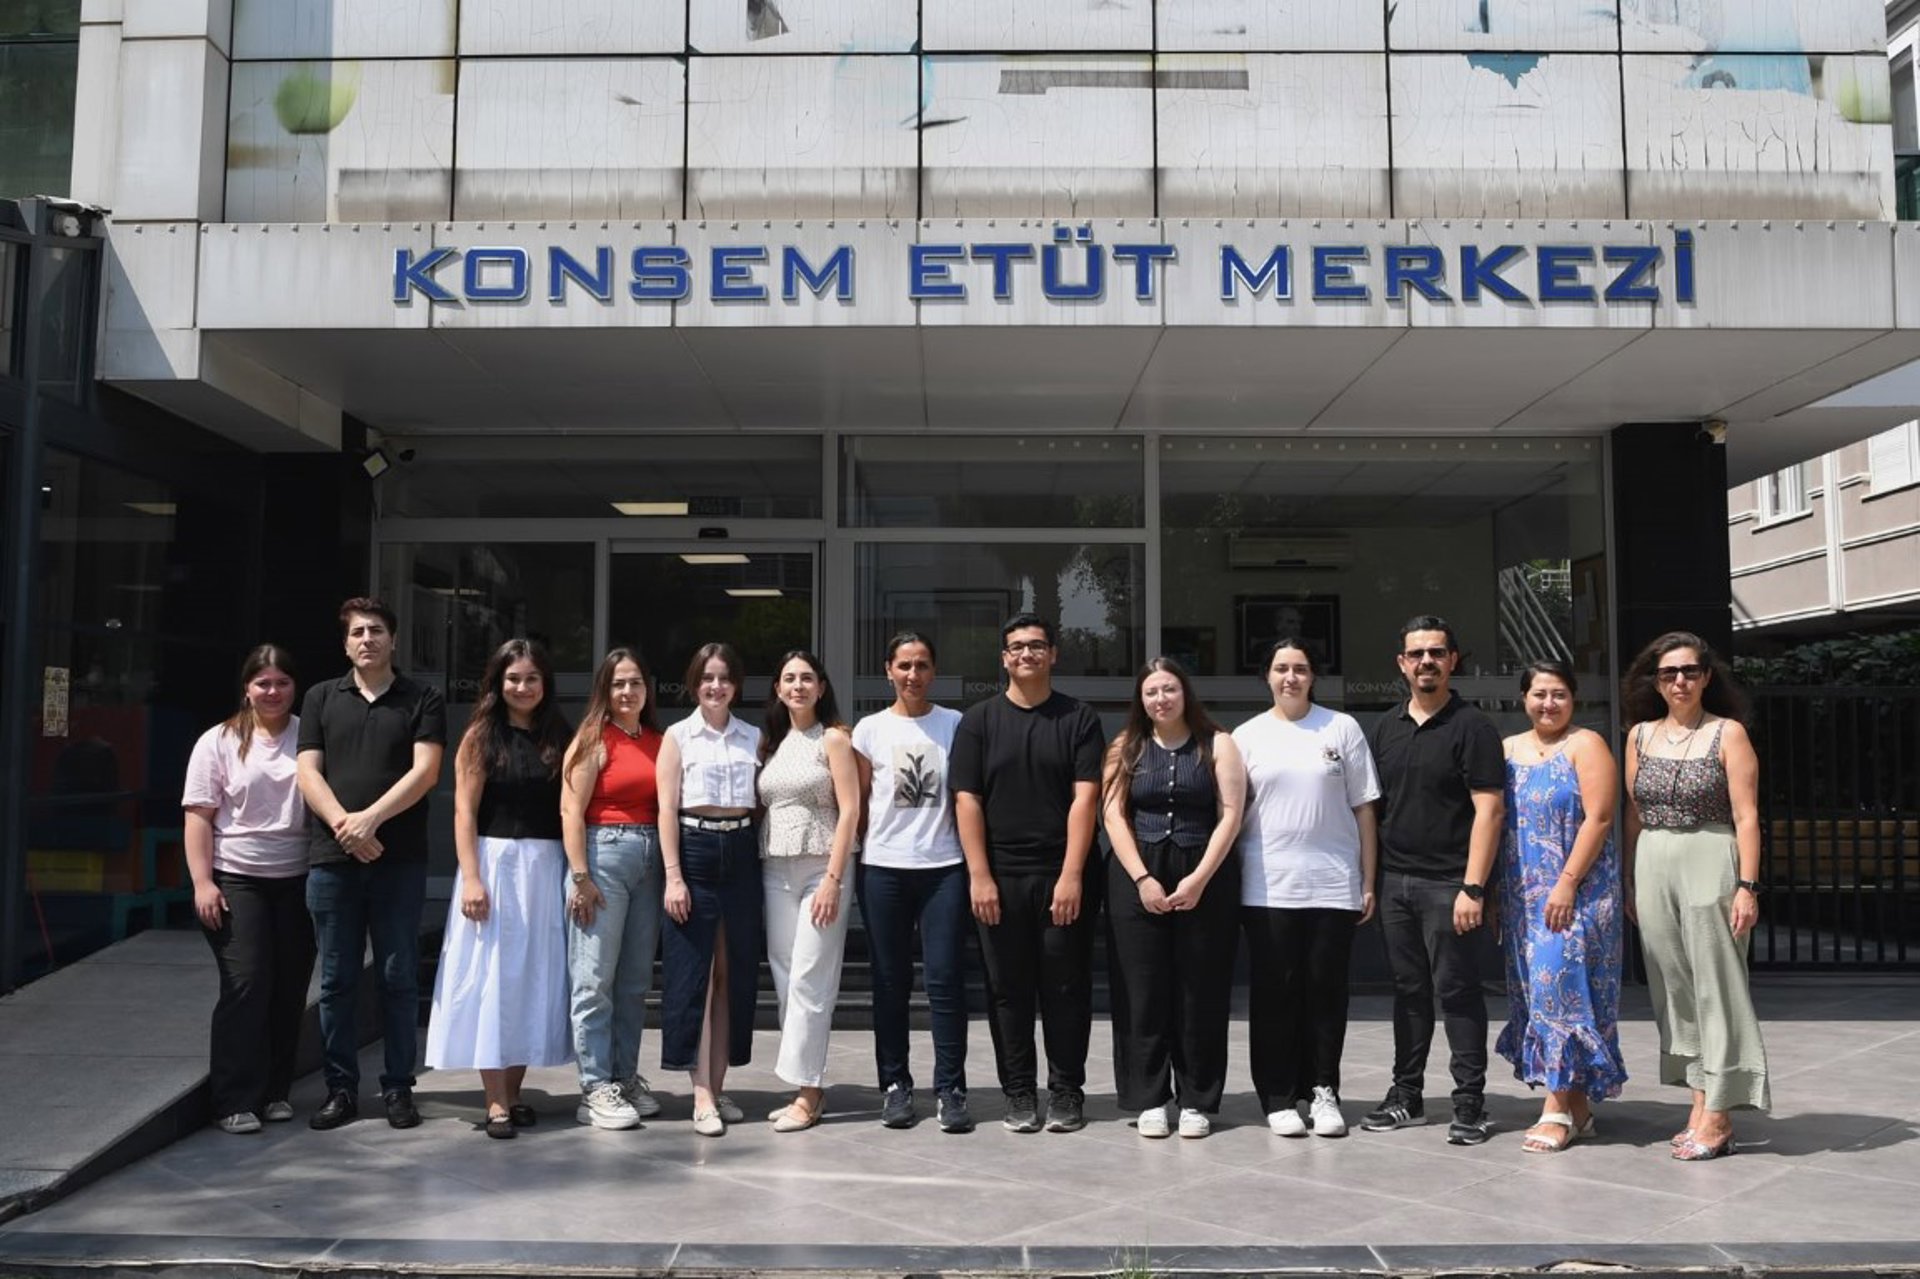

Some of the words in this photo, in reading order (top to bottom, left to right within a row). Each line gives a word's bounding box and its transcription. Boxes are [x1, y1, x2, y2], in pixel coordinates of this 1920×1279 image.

[393, 245, 856, 306] KONSEM
[909, 226, 1177, 302] ETÜT
[1220, 229, 1696, 306] MERKEZİ
